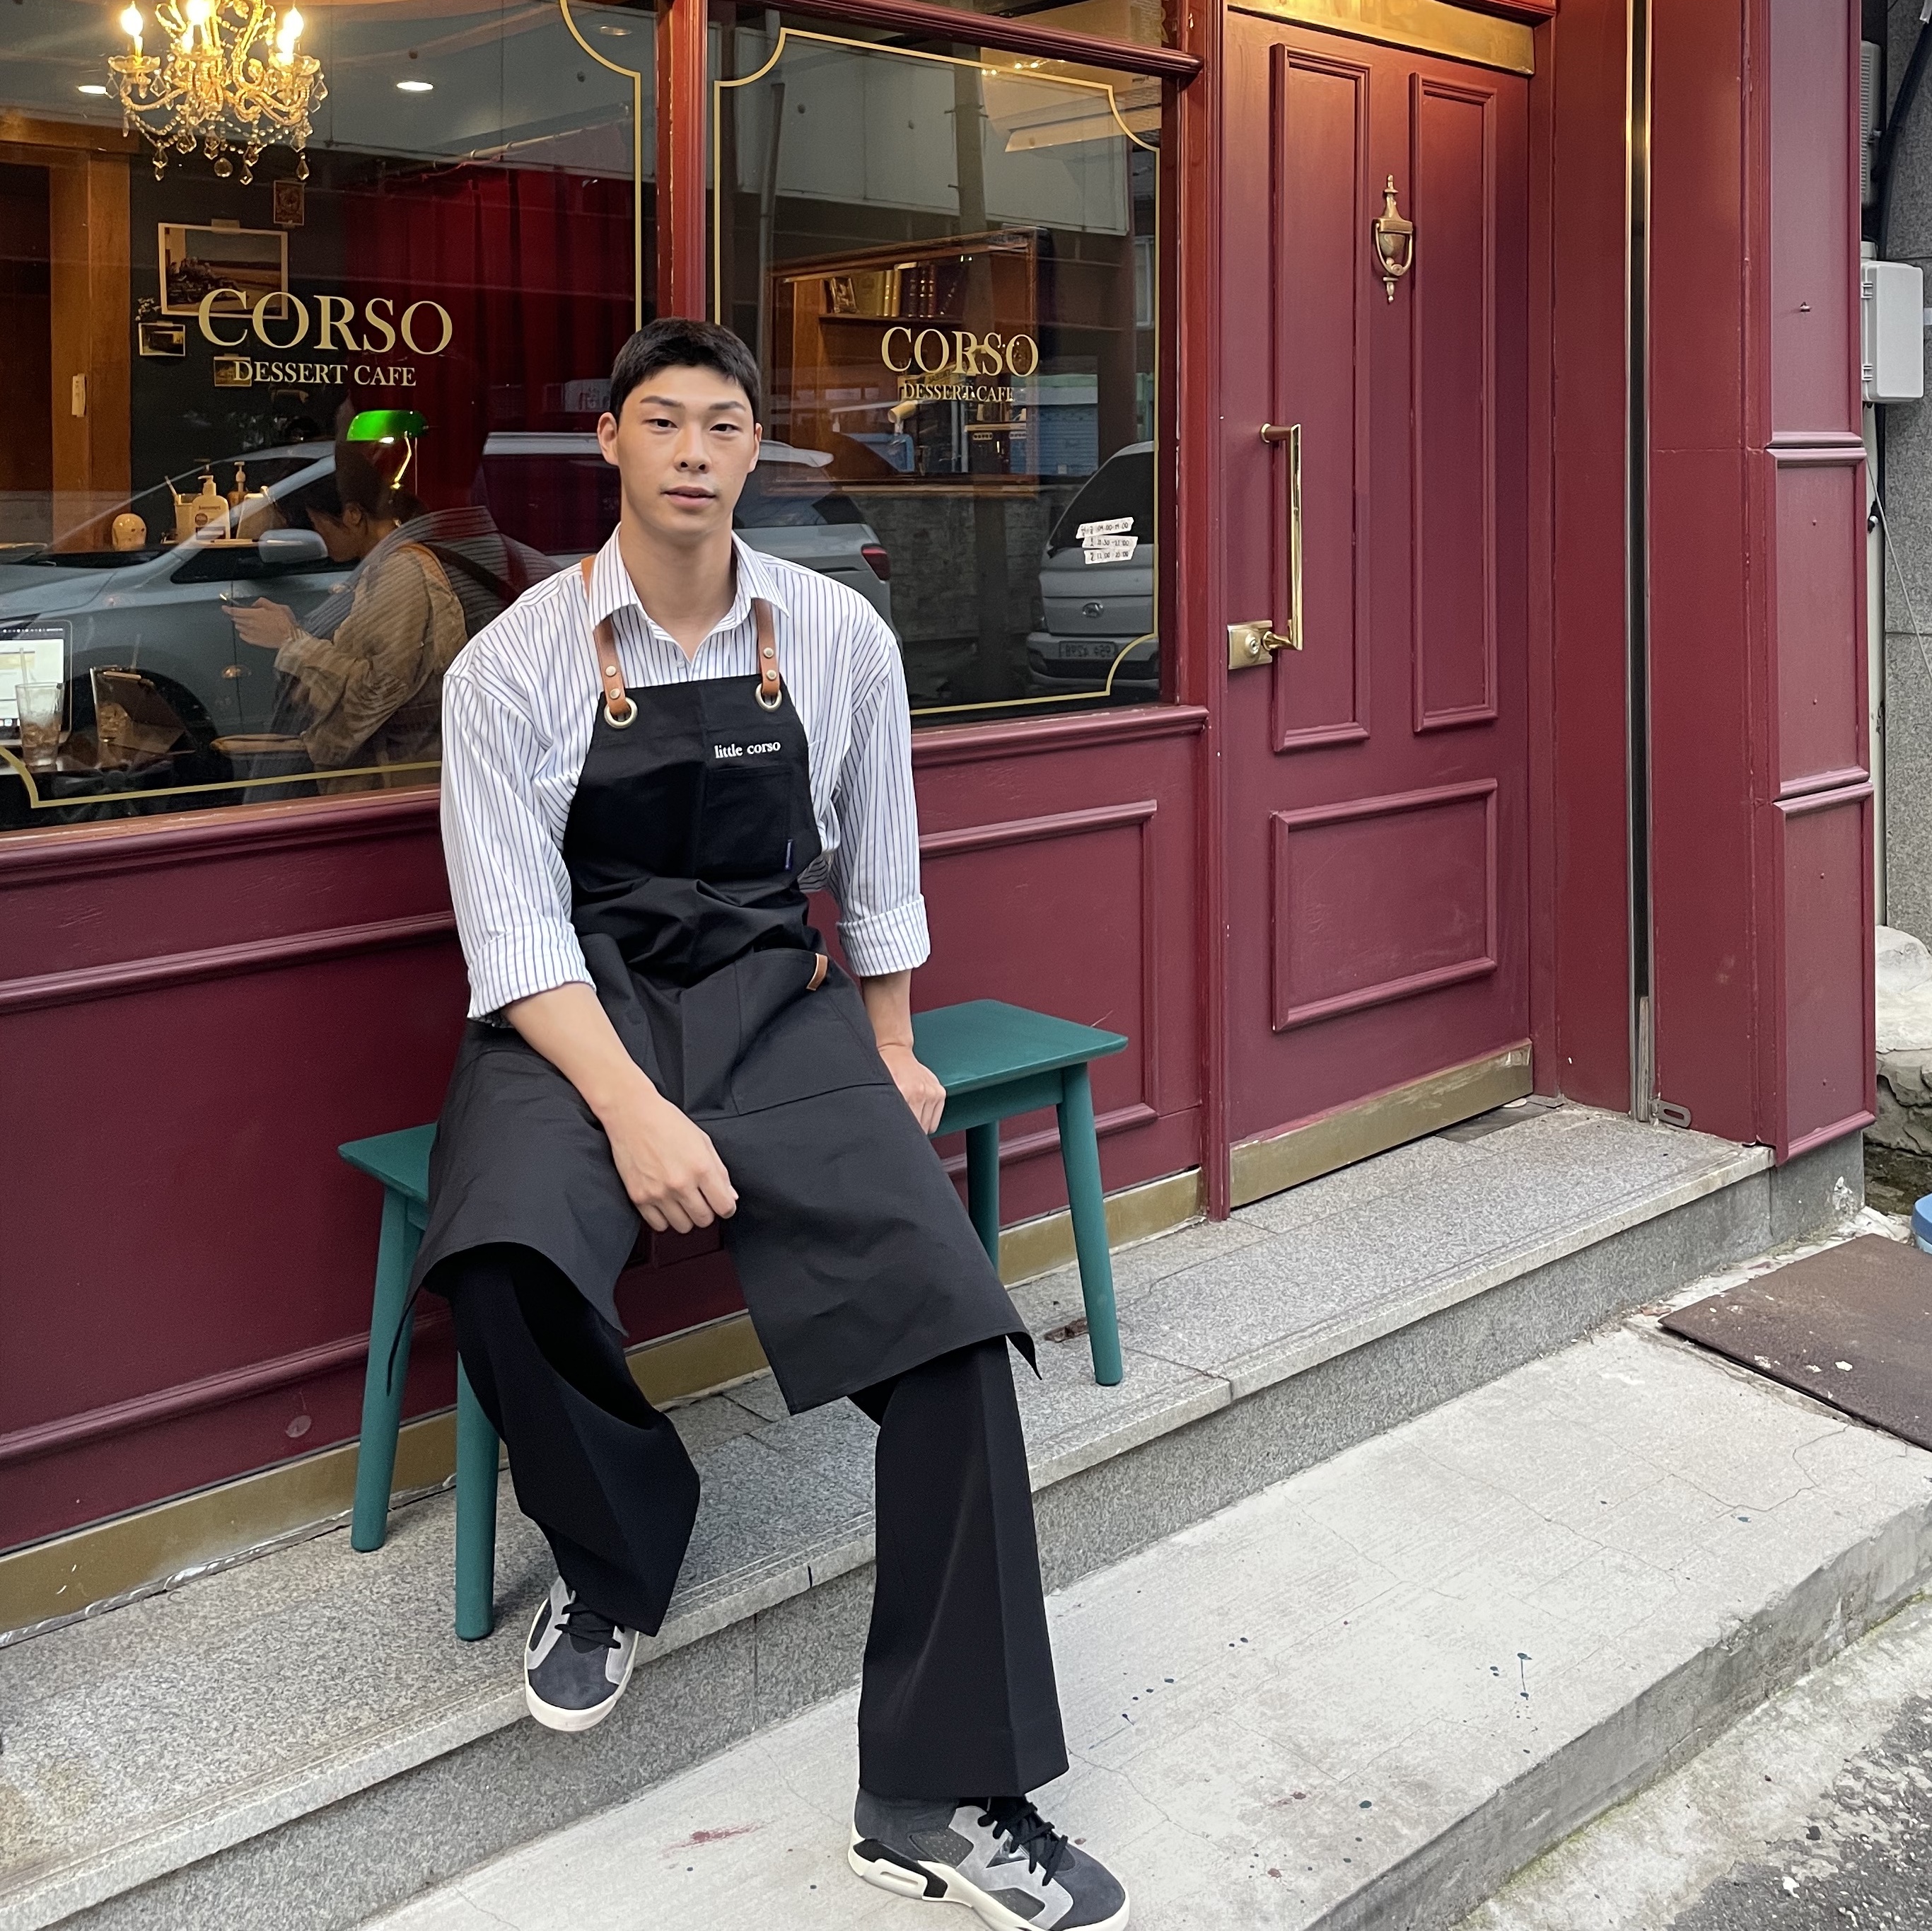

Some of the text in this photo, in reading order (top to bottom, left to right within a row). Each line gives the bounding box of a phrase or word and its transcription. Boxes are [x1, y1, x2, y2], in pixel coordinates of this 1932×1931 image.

[198, 288, 453, 354] CORSO
[881, 326, 1039, 377] CORSO
[233, 361, 417, 386] DESSERT CAFE
[903, 383, 1016, 402] DESSERT CAFE
[714, 741, 781, 759] little corso
